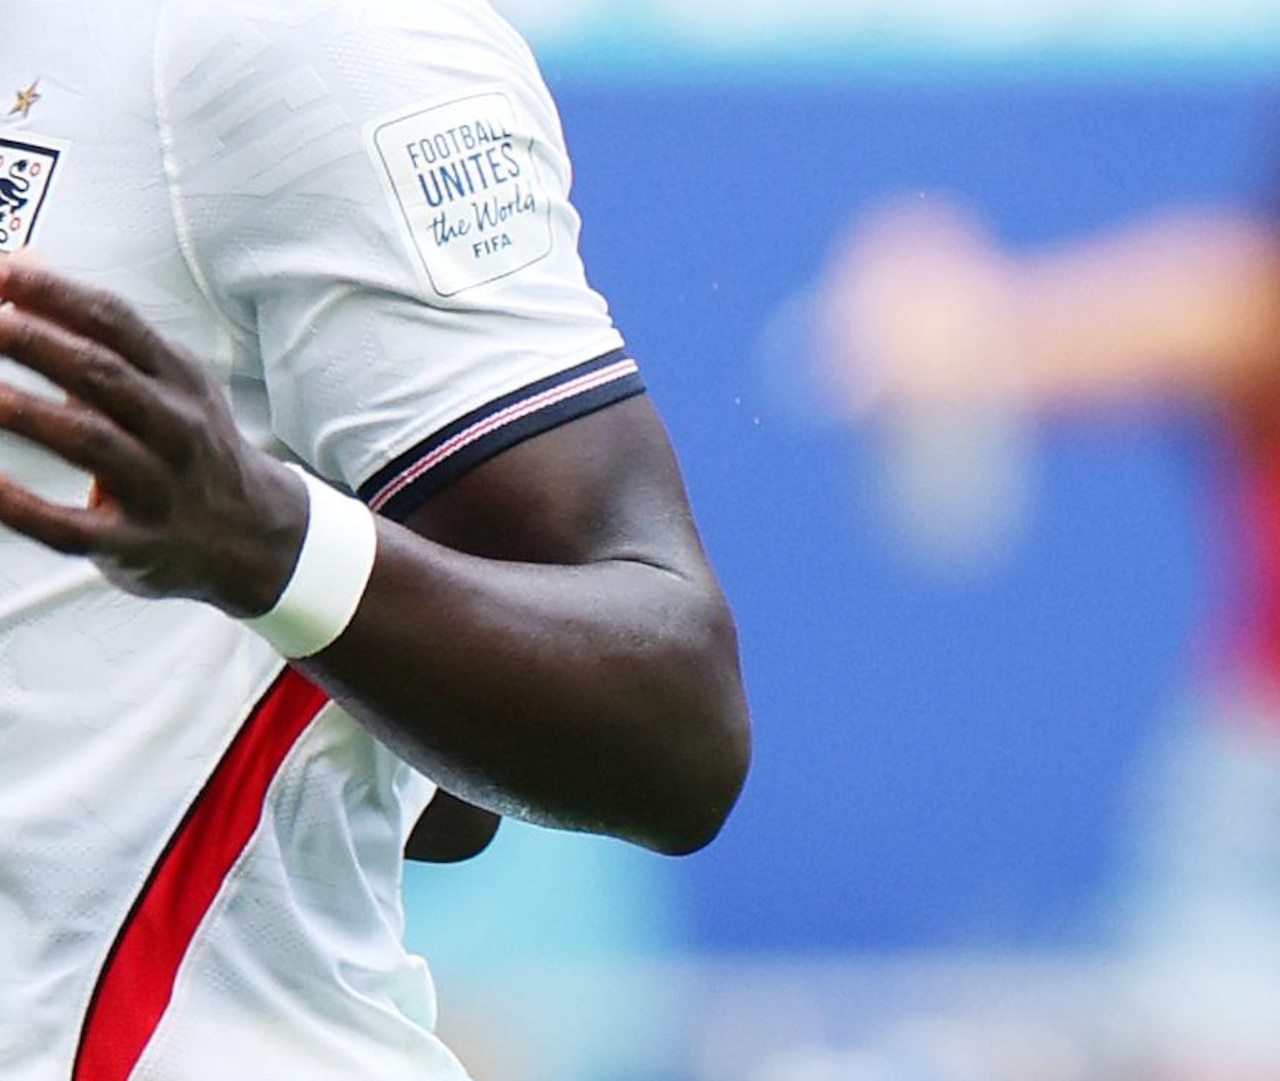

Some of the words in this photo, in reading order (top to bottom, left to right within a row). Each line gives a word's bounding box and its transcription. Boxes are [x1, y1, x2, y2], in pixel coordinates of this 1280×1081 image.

[406, 119, 513, 169] FOOTBALL
[418, 142, 521, 208] UNITES
[428, 212, 471, 247] the
[471, 183, 536, 232] World
[471, 233, 513, 259] FIFA
